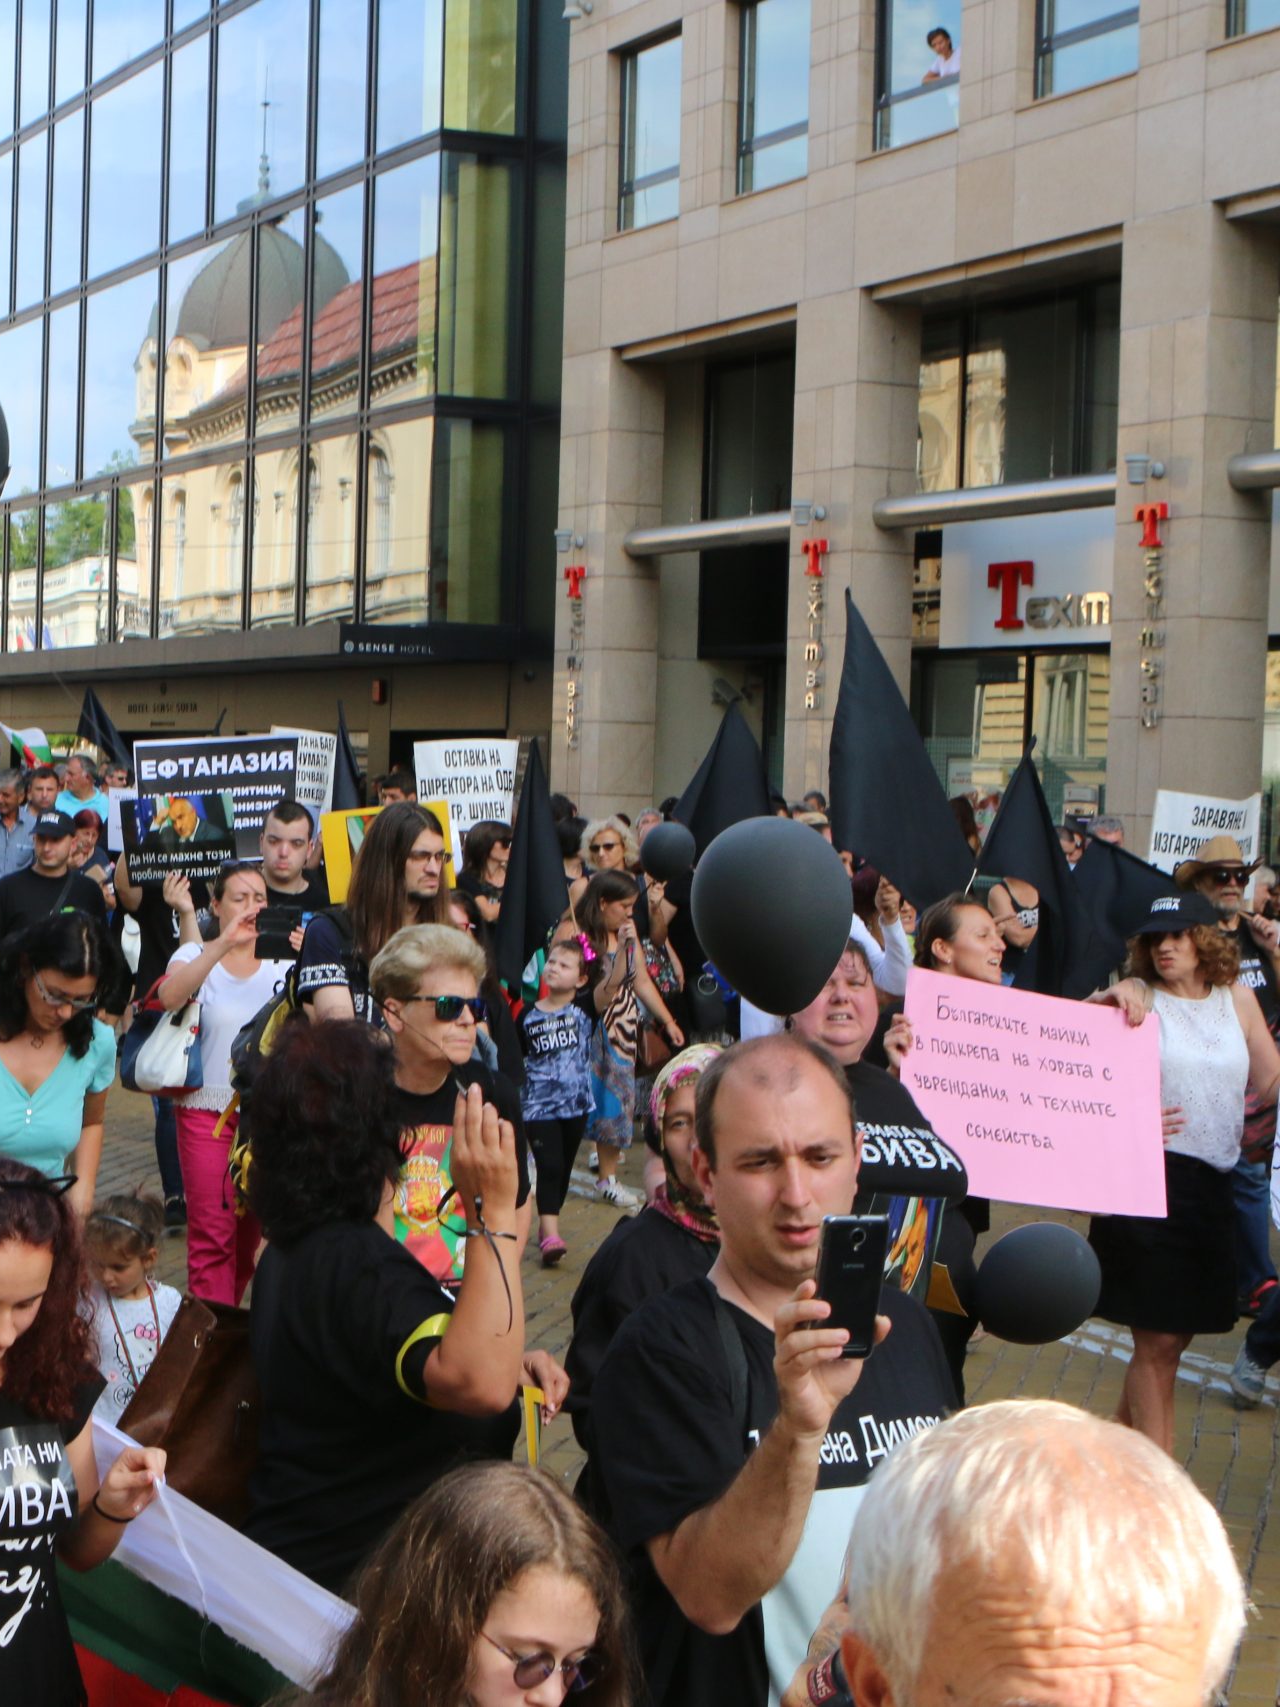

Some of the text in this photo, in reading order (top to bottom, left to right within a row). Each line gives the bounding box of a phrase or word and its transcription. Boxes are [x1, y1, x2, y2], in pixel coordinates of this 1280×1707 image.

[358, 642, 434, 655] SENSE HOTEL
[141, 750, 294, 781] ЕФТАНАЗИЯ
[444, 748, 502, 768] ОСТАВКА НА
[420, 769, 515, 800] ДИРЕКТОРА НА ОДБ
[451, 801, 506, 820] ГР. ШУМЕН
[1192, 805, 1243, 830] ЗАРАВЯНЕ
[1154, 831, 1209, 856] ИЗГАРЯН
[129, 849, 231, 866] Да НИ се махне този
[532, 1029, 578, 1054] УБИВА
[1039, 1024, 1090, 1046] майки
[931, 1039, 1000, 1062] подкрепа
[1012, 1052, 1030, 1067] на
[1038, 1057, 1093, 1080] хората
[1038, 1095, 1116, 1118] техните
[966, 1122, 1054, 1151] семейства
[861, 1135, 963, 1172] БИВА
[38, 1441, 62, 1465] НИ
